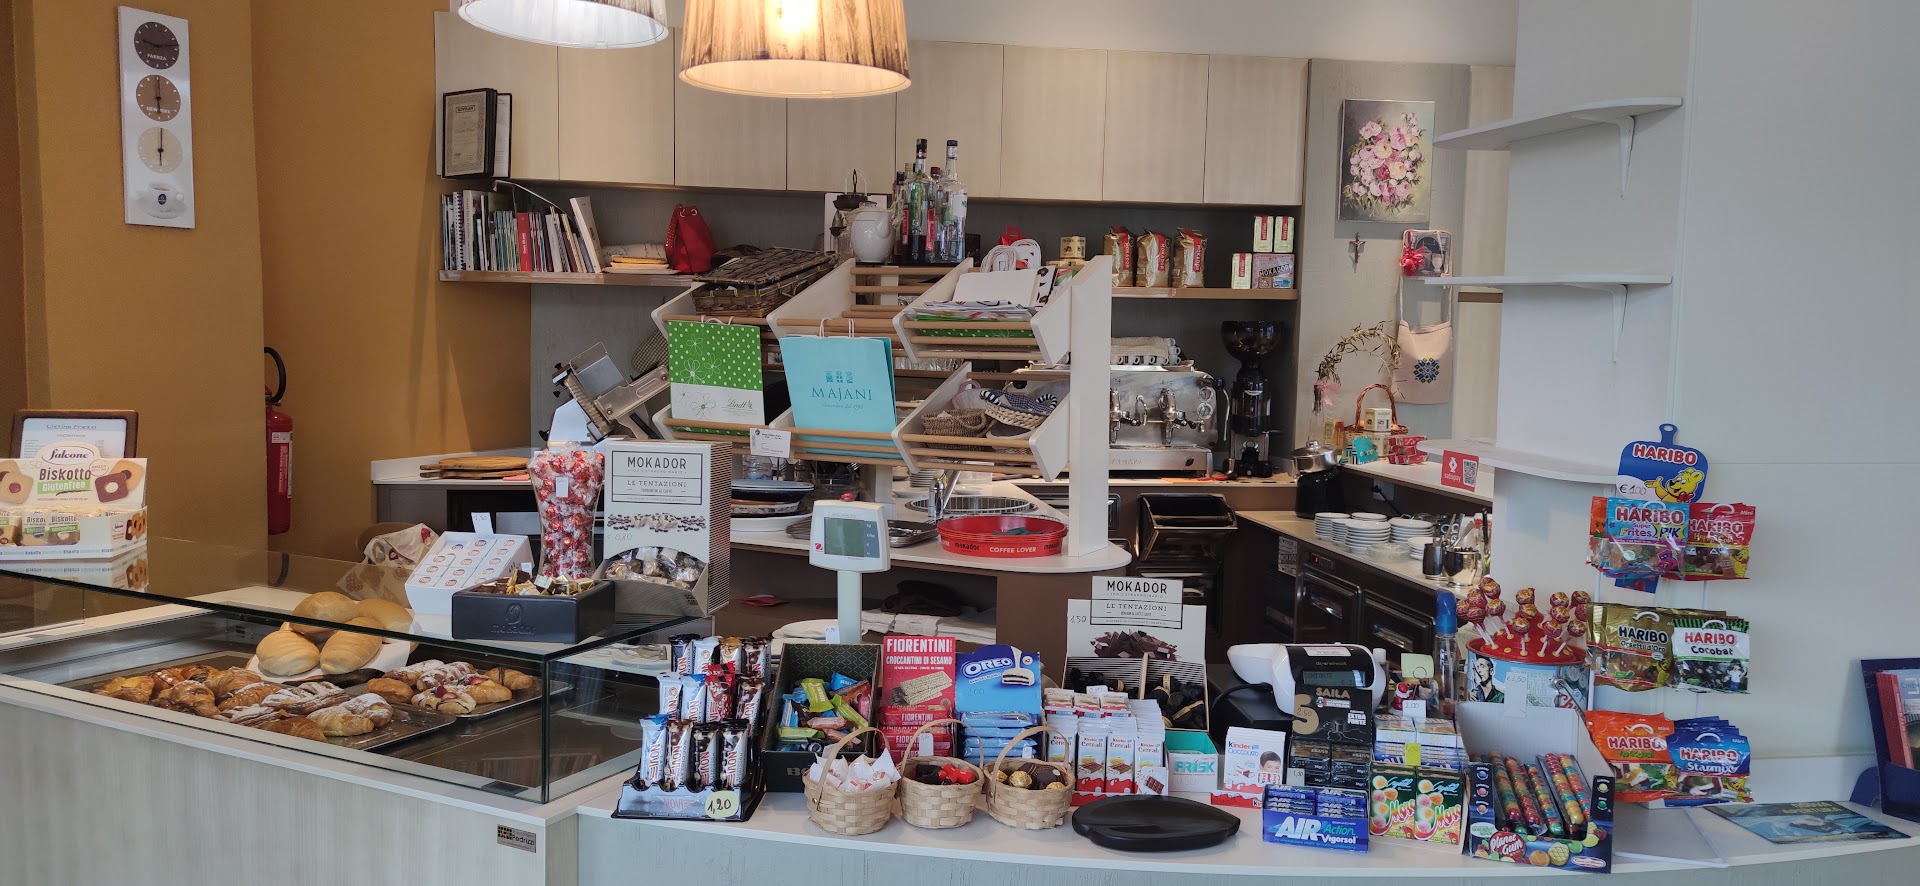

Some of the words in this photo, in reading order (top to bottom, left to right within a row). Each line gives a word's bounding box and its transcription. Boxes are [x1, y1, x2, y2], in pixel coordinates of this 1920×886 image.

[1258, 264, 1290, 276] MOKADOR
[812, 387, 872, 401] MAJANI
[727, 398, 747, 408] Lindt
[49, 449, 88, 460] falcone
[1634, 444, 1697, 465] HARIBO
[627, 456, 686, 469] MOKADOR
[40, 467, 91, 480] Biskotto
[1444, 473, 1461, 482] satispay
[1620, 527, 1652, 537] Frites
[1107, 580, 1167, 594] MOKADOR
[1618, 626, 1669, 644] HARIBO
[1684, 632, 1736, 645] HARIBO
[886, 639, 950, 652] FIORENTINI
[1620, 640, 1646, 650] Orsetti
[1691, 646, 1733, 655] Cocobat
[886, 656, 922, 664] CROCCANTINI
[923, 656, 929, 664] DI
[930, 656, 952, 665] SESAMO
[964, 658, 1012, 675] OREO
[1316, 688, 1350, 699] SAILA
[1229, 741, 1250, 749] kinder
[1608, 737, 1666, 751] HARIBO
[1228, 748, 1259, 756] CIOCCOLATO
[1680, 748, 1738, 762] HARIBO
[700, 751, 710, 780] NOVI
[727, 751, 737, 779] NOVI
[1175, 760, 1214, 773] FRISK
[1688, 762, 1735, 774] Starmix
[662, 799, 689, 809] NOVI
[707, 798, 732, 814] 1,20
[1275, 816, 1321, 840] AIR
[1323, 824, 1356, 836] Action
[1322, 834, 1356, 844] Vigorsol
[1490, 834, 1517, 852] Planet
[1502, 840, 1523, 854] Gum
